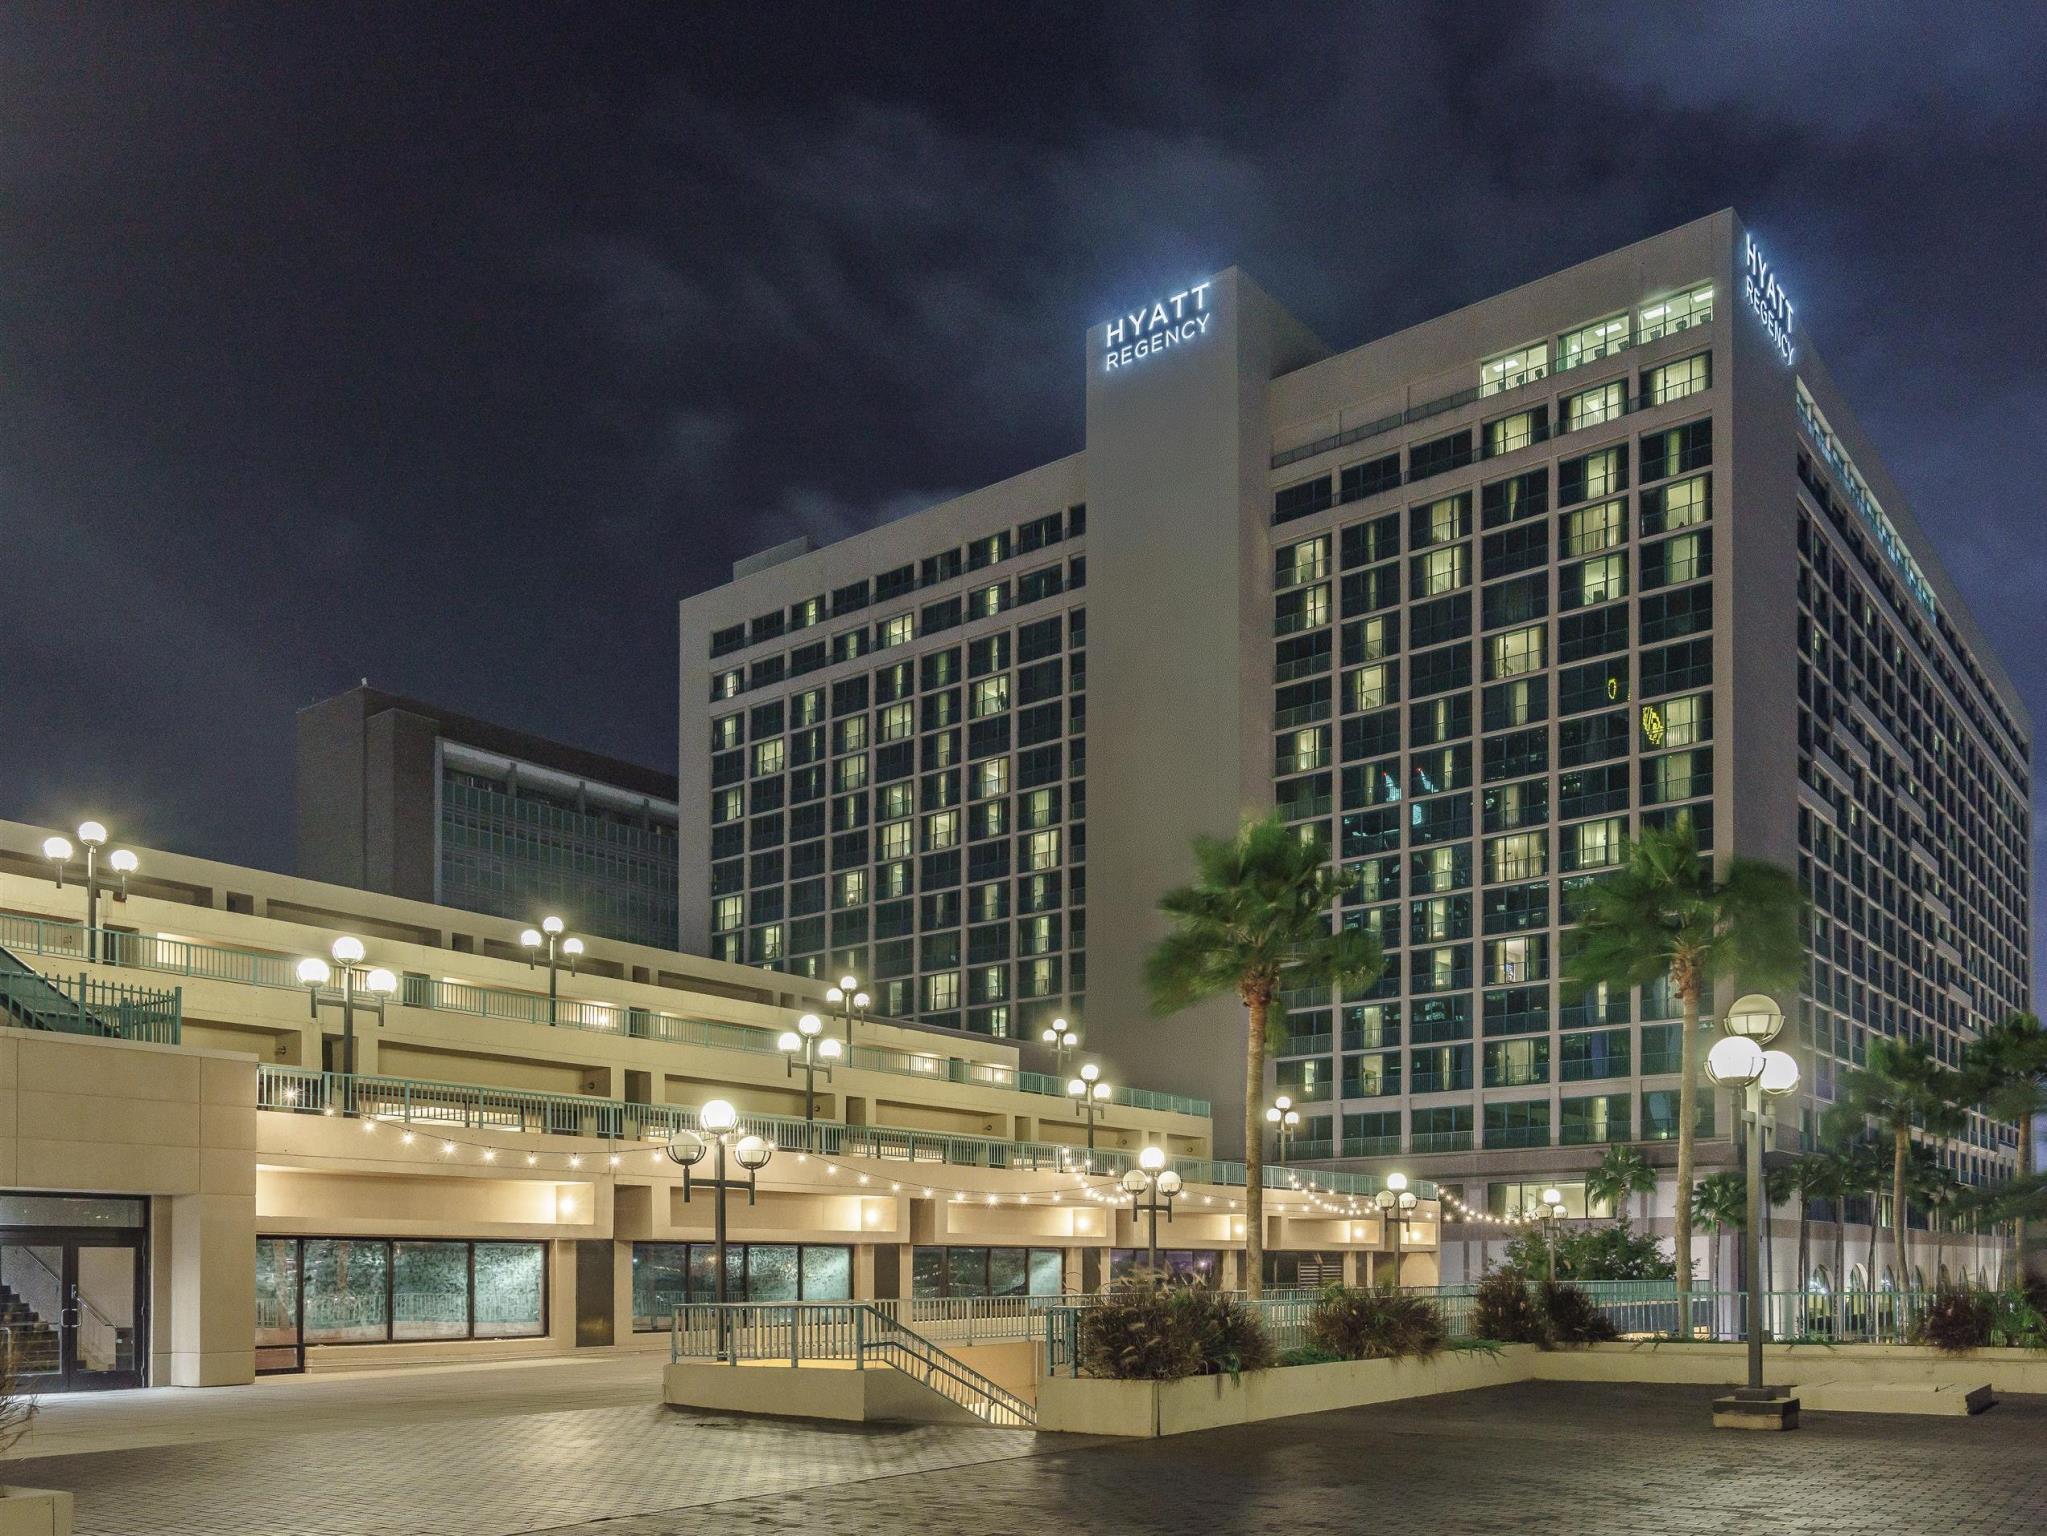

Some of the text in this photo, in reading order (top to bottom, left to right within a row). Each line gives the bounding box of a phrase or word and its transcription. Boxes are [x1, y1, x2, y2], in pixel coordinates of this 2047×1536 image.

[1106, 281, 1210, 347] HYATT
[1746, 233, 1793, 333] HYATT
[1746, 275, 1794, 366] REGENCY
[1106, 312, 1210, 371] REGENCY
